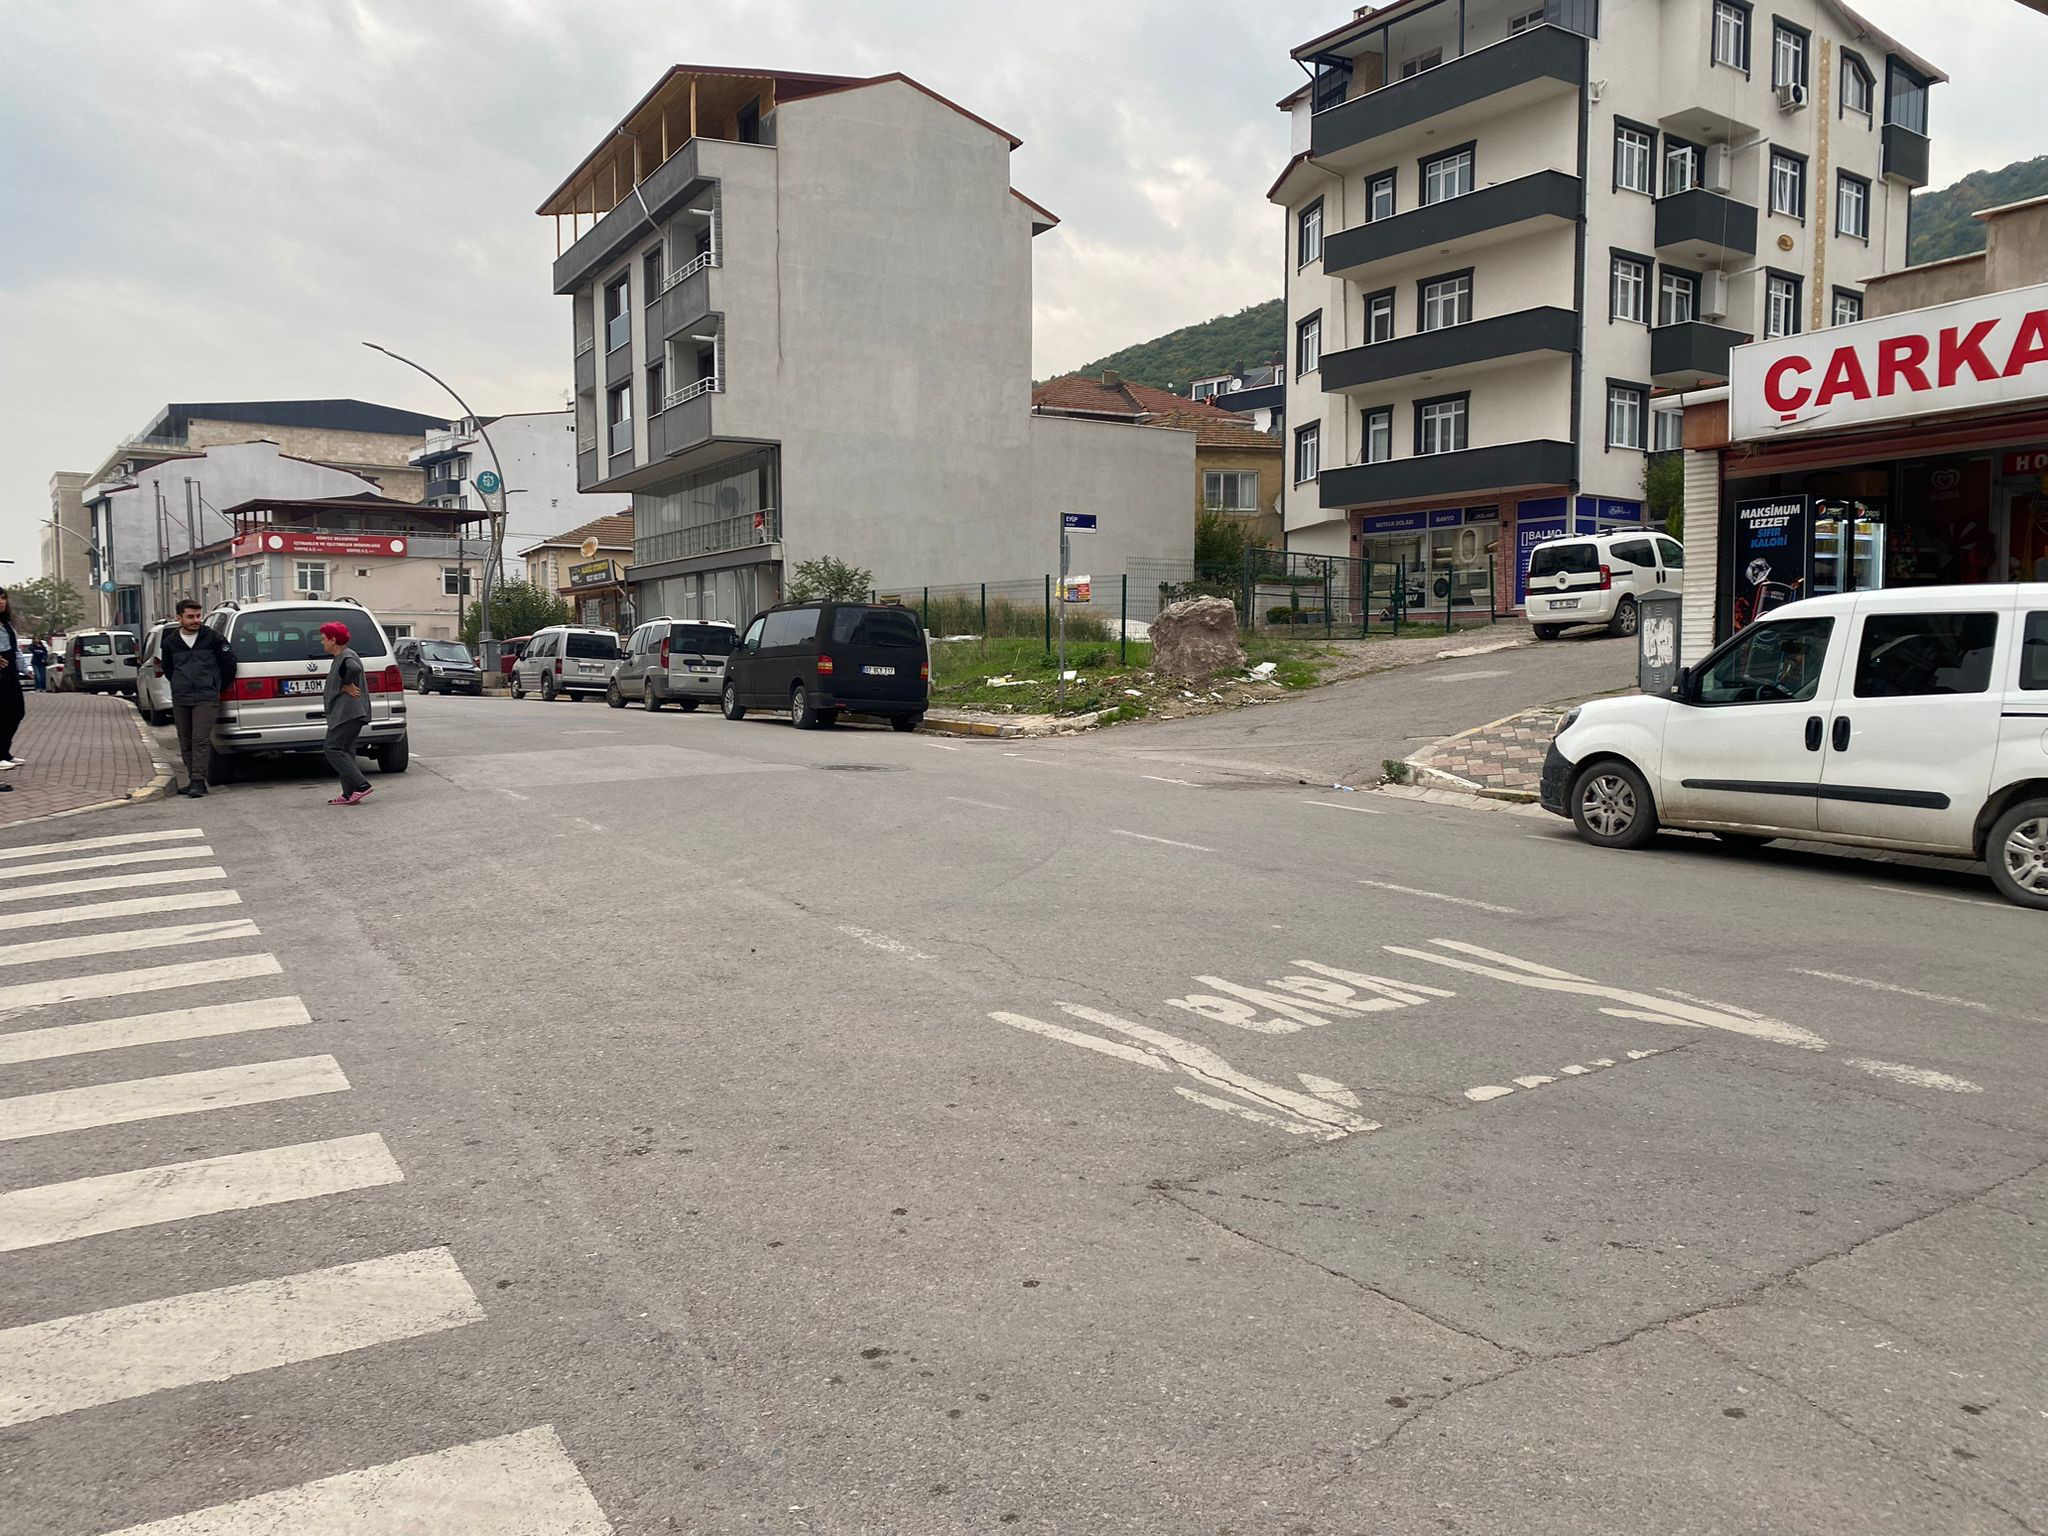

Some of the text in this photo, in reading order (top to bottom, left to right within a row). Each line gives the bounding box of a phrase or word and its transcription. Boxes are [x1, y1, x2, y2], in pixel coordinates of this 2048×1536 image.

[1764, 309, 2048, 422] ÇARKA
[1740, 504, 1800, 519] MAKSİMUM
[1395, 519, 1415, 527] DOLABI
[1435, 515, 1455, 523] BANYO
[1750, 516, 1790, 529] LEZZET
[1757, 527, 1781, 538] SIFIR
[1750, 534, 1788, 548] KALORİ
[289, 681, 300, 690] 41
